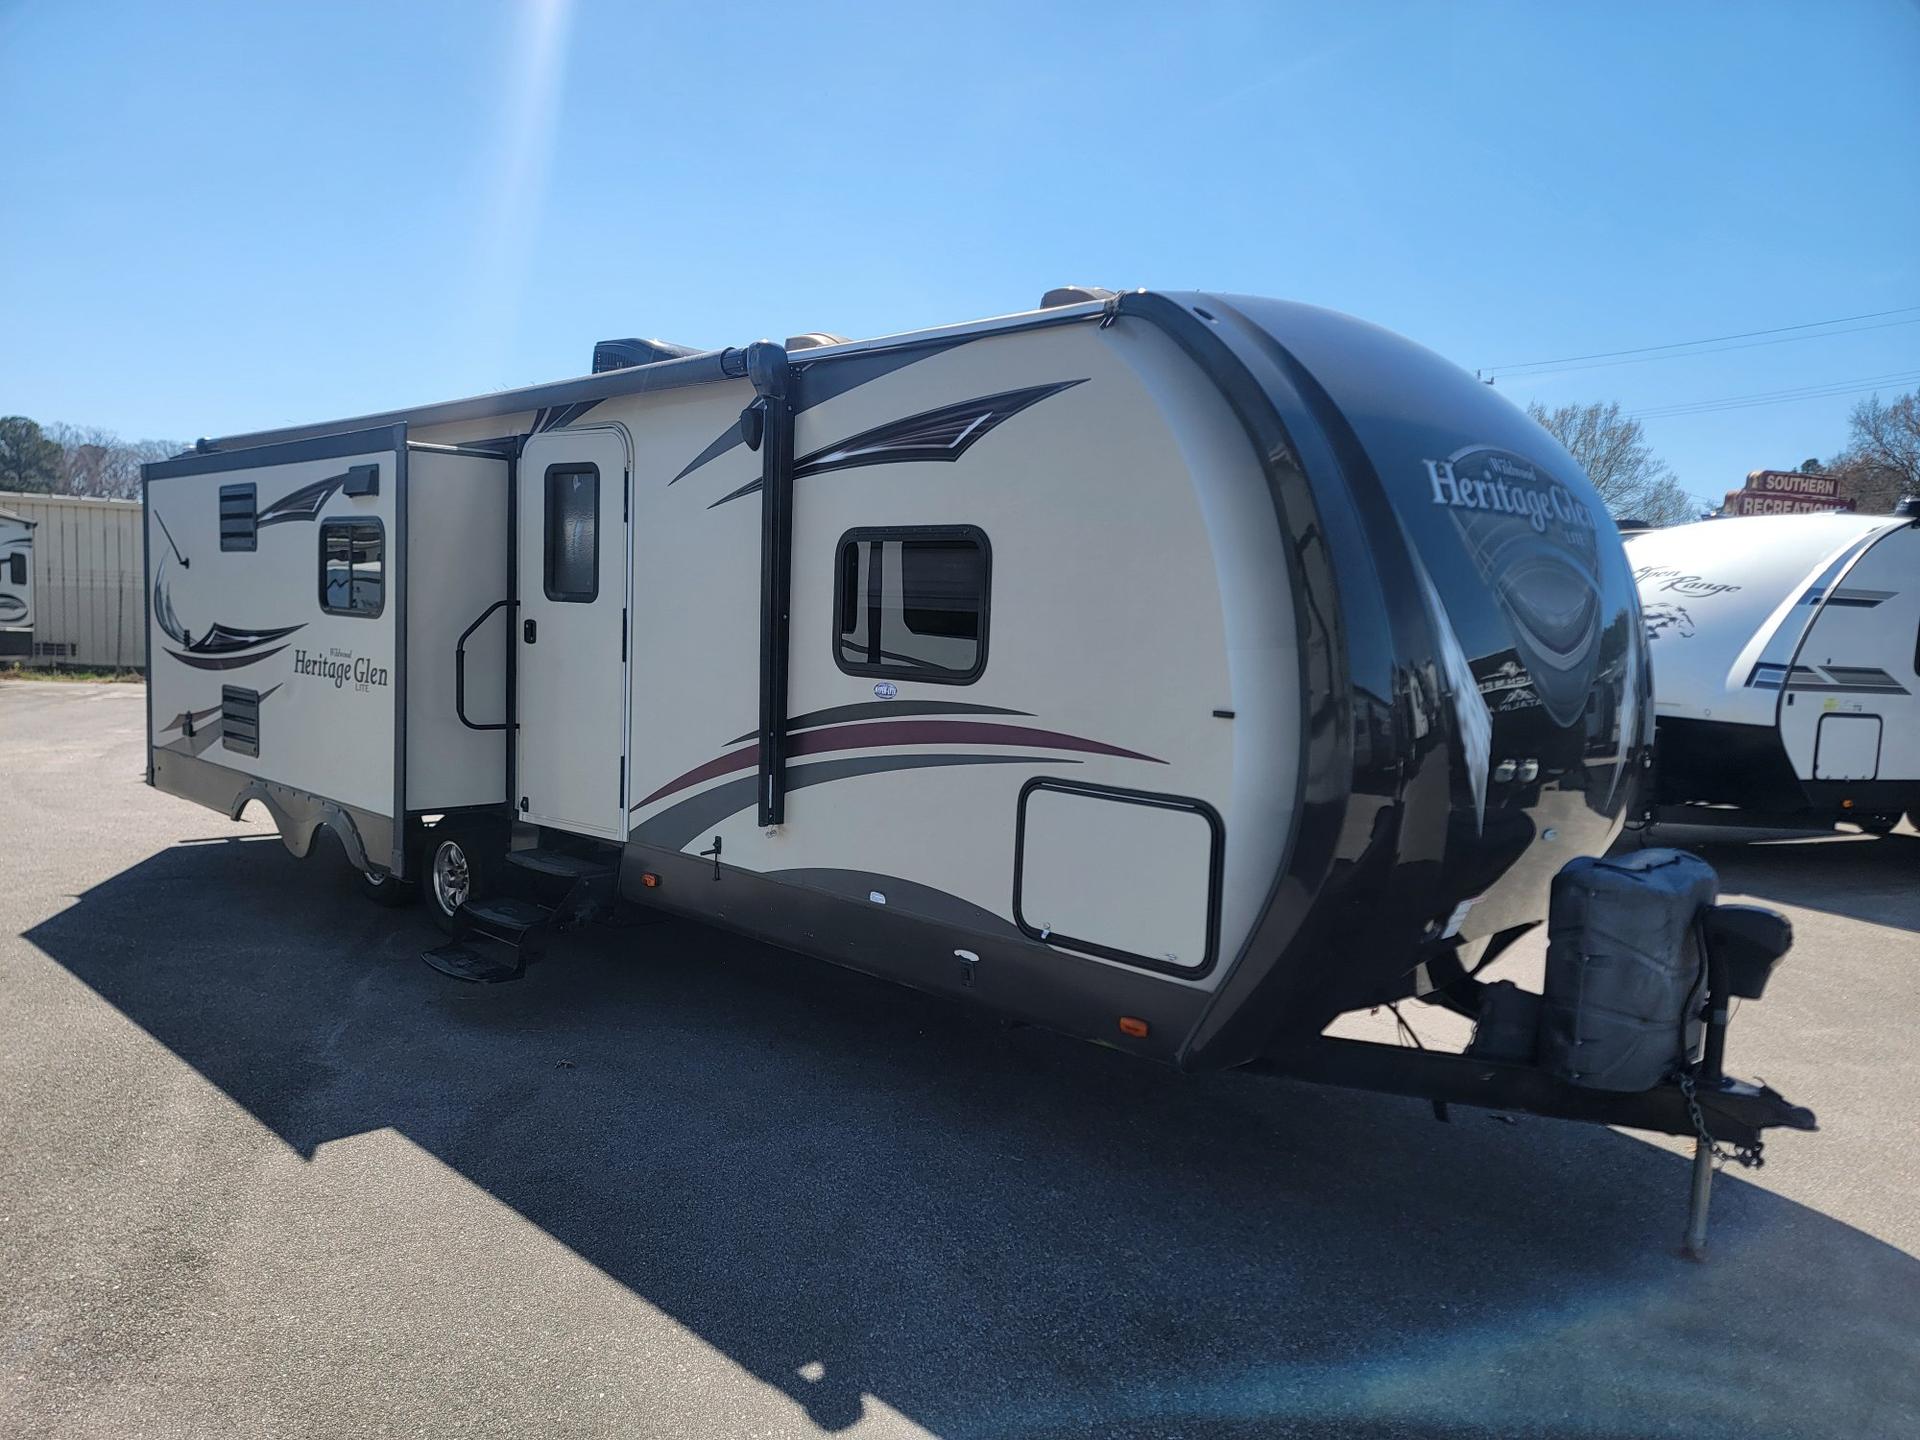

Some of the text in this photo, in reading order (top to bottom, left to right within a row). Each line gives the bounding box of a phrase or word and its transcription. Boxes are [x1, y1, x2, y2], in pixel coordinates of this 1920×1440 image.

[1422, 458, 1597, 533] Heritage Glen
[1766, 474, 1835, 494] SOUTHERN
[1658, 575, 1743, 598] Range
[294, 649, 388, 688] Heritage Glen
[355, 684, 370, 693] LITE
